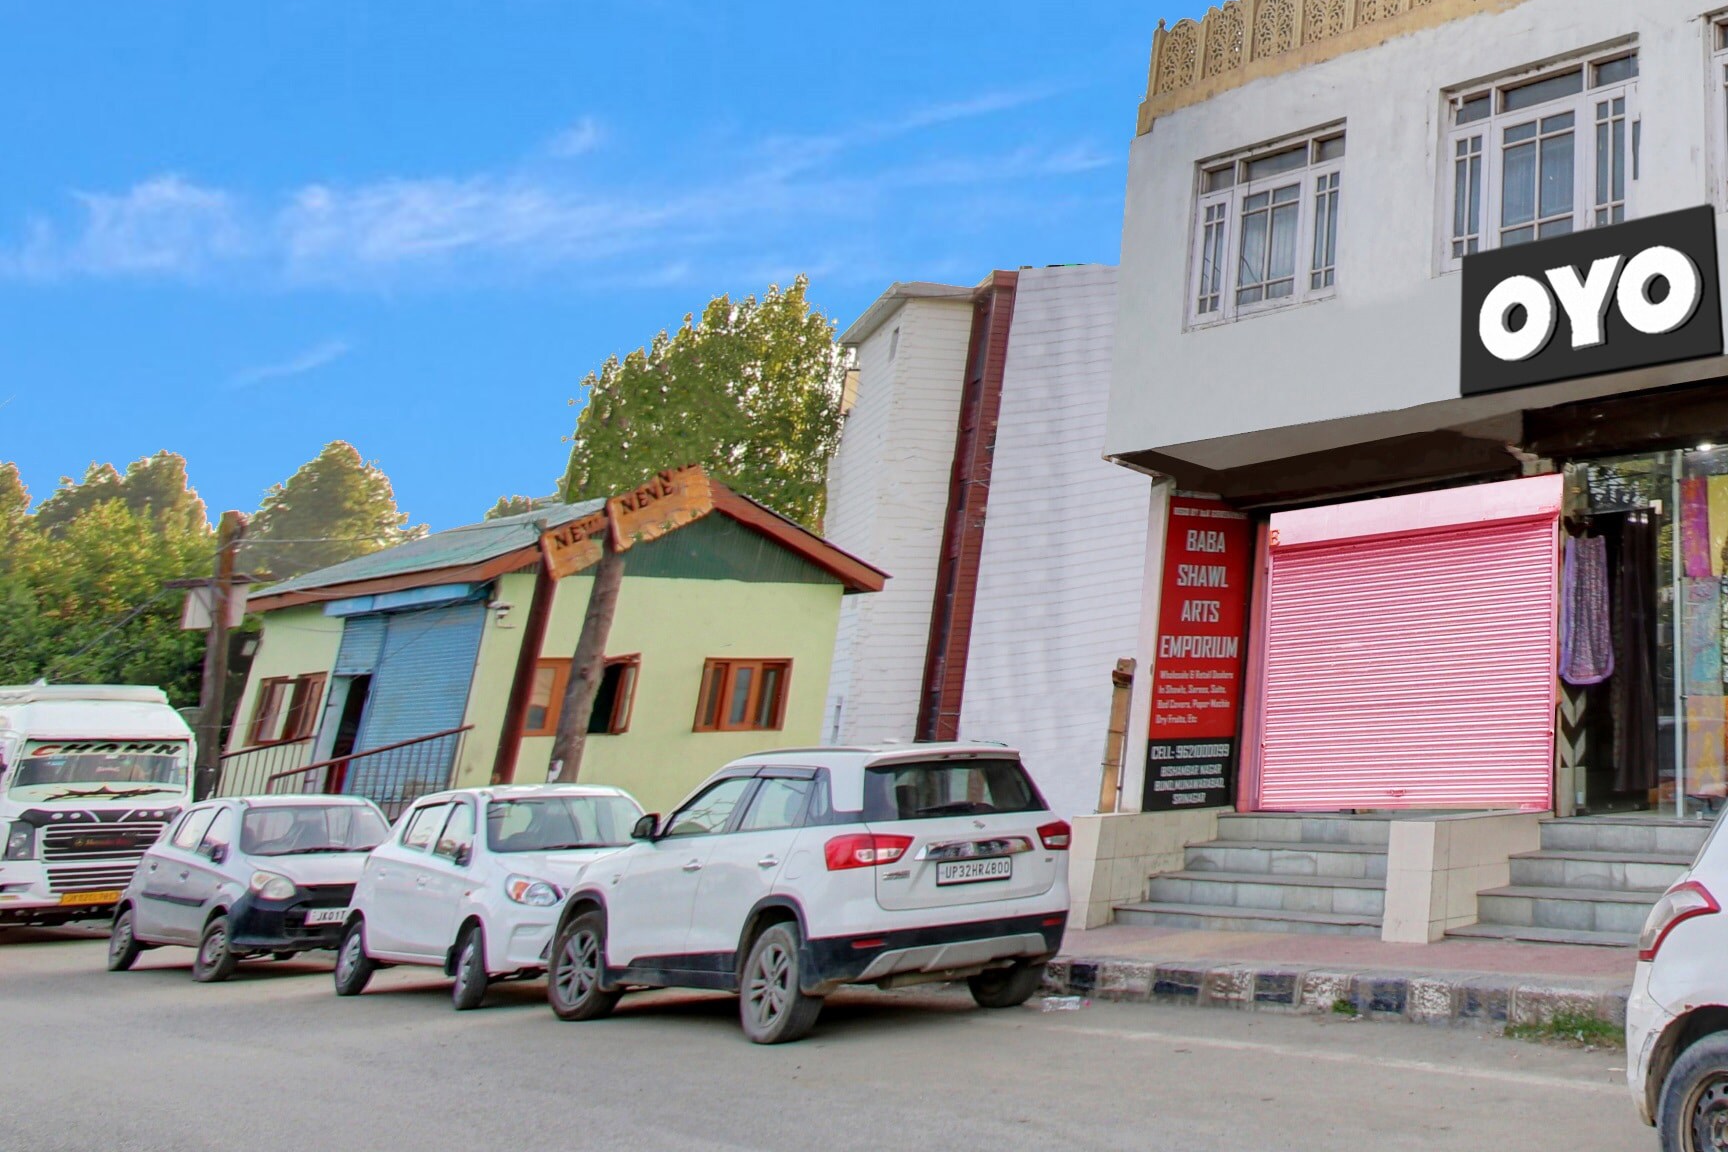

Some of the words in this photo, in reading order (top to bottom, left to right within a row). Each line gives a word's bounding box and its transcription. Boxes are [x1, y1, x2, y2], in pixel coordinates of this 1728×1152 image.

[1479, 245, 1700, 362] OYO
[1186, 529, 1226, 553] BABA
[1176, 564, 1229, 587] SHAWL
[1181, 599, 1220, 622] ARTS
[1159, 635, 1239, 658] EMPORIUM
[945, 861, 1010, 879] UP32HR4800
